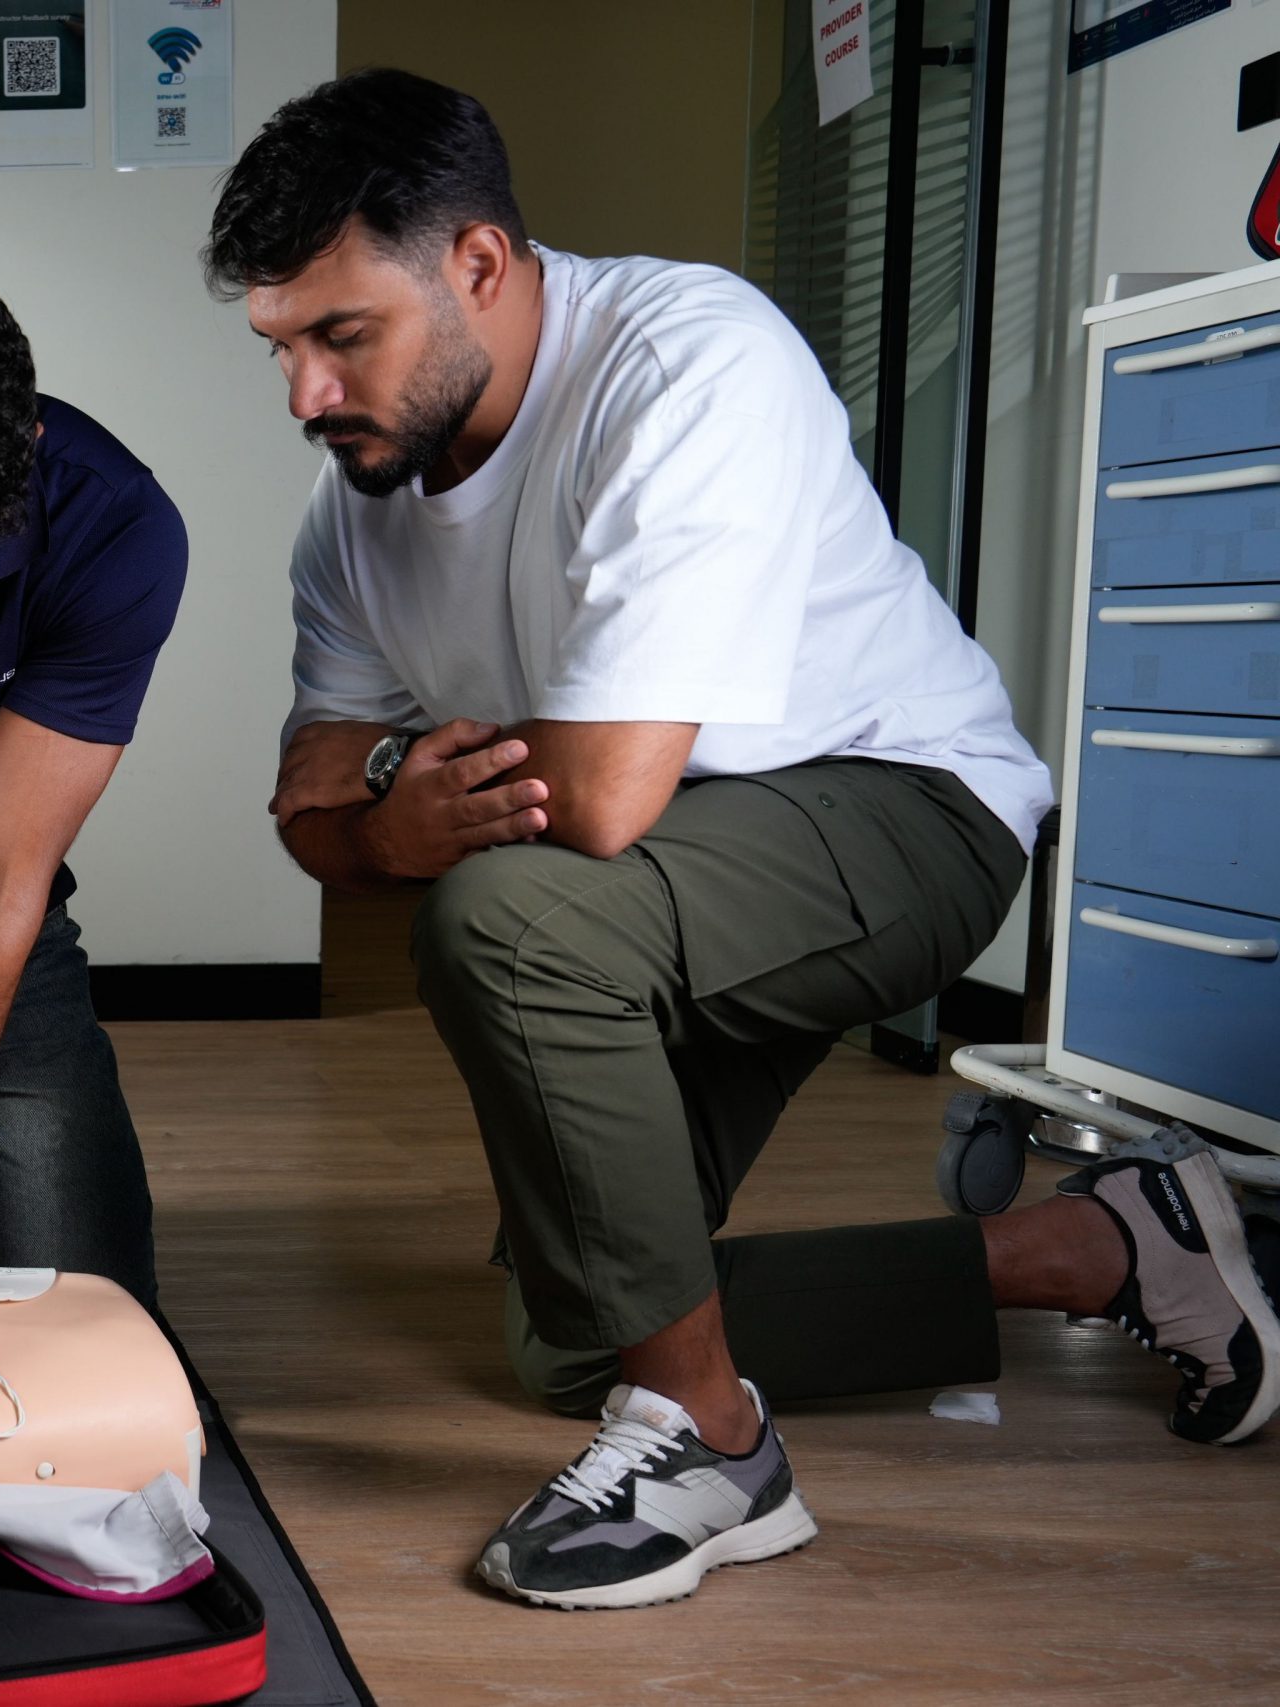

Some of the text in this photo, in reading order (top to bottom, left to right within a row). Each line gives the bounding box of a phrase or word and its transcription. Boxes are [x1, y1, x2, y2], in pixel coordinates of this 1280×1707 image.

[820, 3, 862, 41] PROVIDER
[825, 34, 859, 67] COURSE
[1157, 1172, 1191, 1231] new balance
